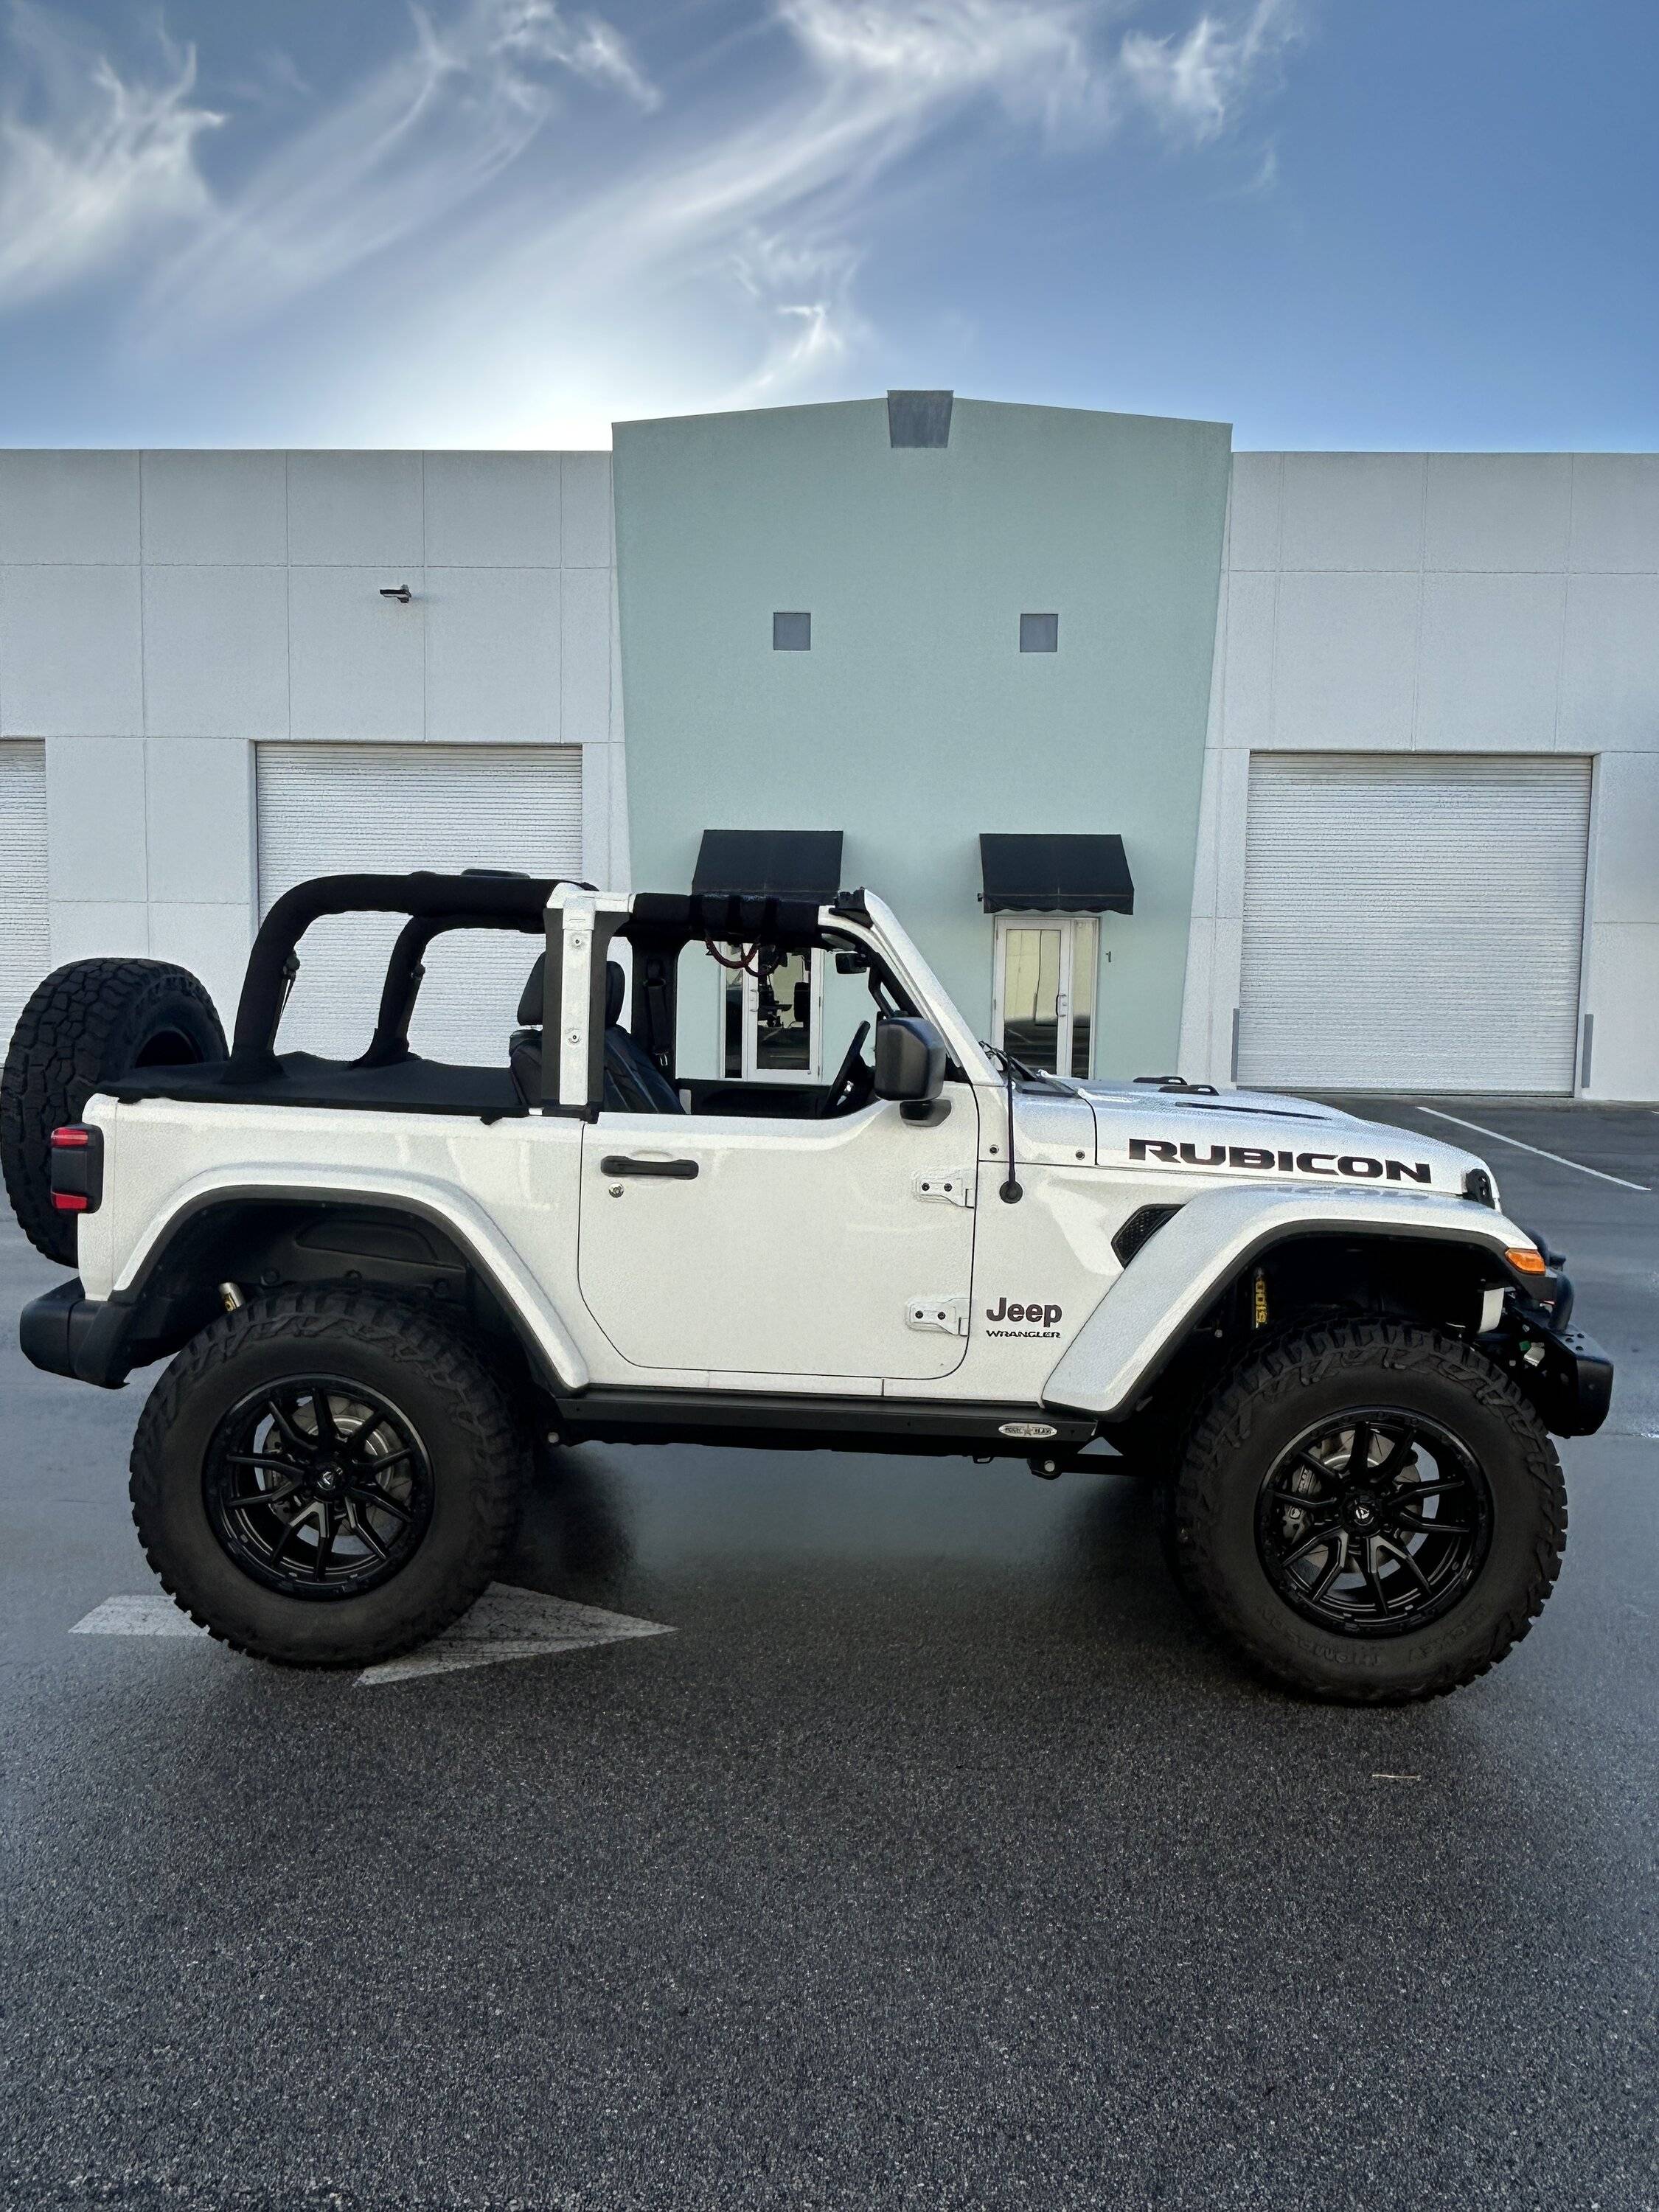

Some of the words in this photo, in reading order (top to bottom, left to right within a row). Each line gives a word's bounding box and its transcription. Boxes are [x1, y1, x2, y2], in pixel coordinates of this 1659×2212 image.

[1105, 951, 1111, 963] 1
[1129, 1138, 1432, 1184] RUBICON
[986, 1297, 1062, 1328] Jeep
[986, 1329, 1061, 1338] WRANGLER
